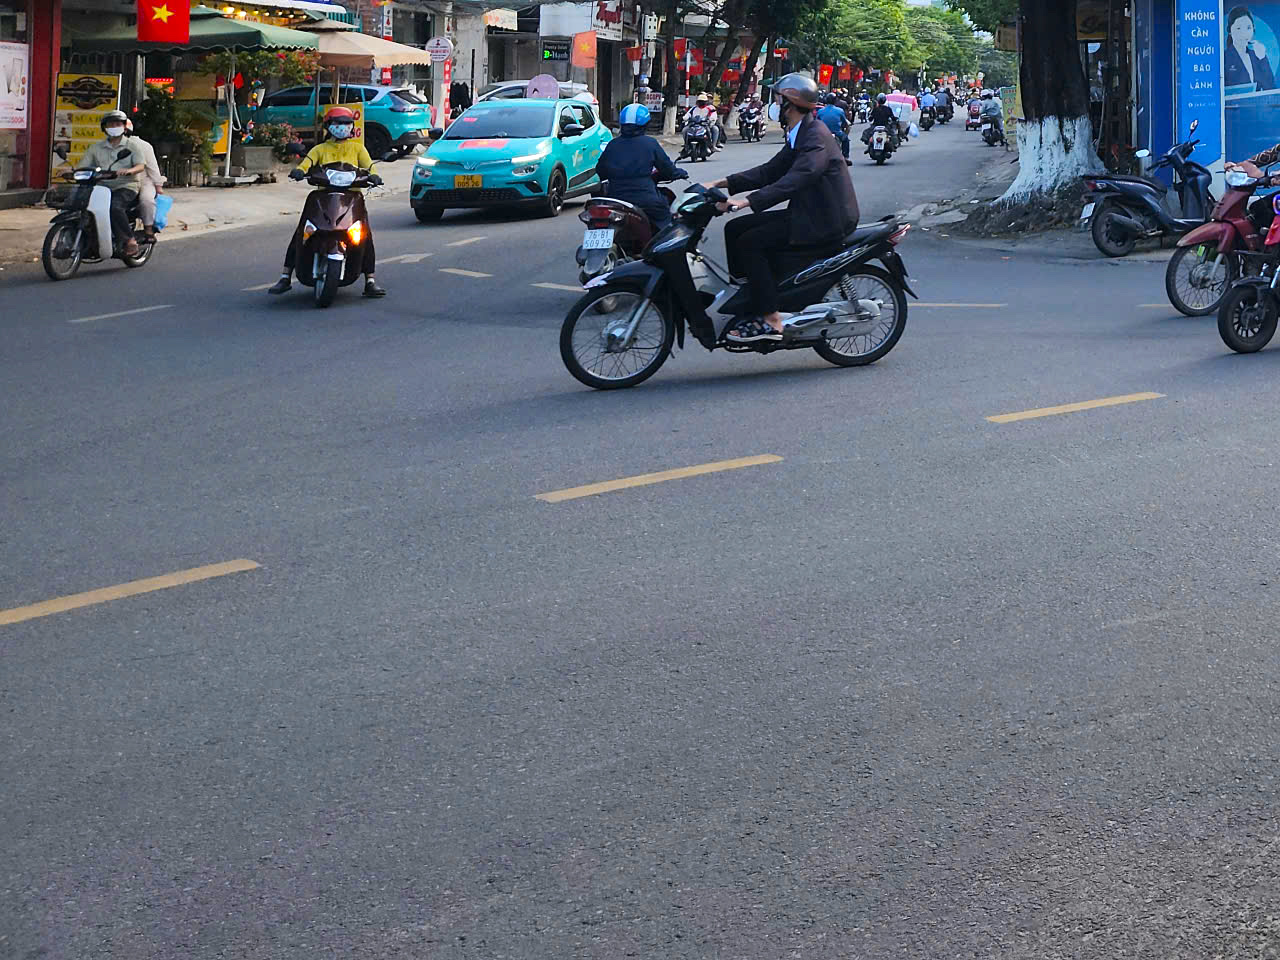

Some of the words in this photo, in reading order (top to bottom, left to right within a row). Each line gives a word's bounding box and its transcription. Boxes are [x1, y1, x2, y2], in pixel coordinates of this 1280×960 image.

[1184, 9, 1216, 21] KHÔNG
[1191, 26, 1209, 37] CẦN
[1187, 43, 1215, 55] NGƯỜI
